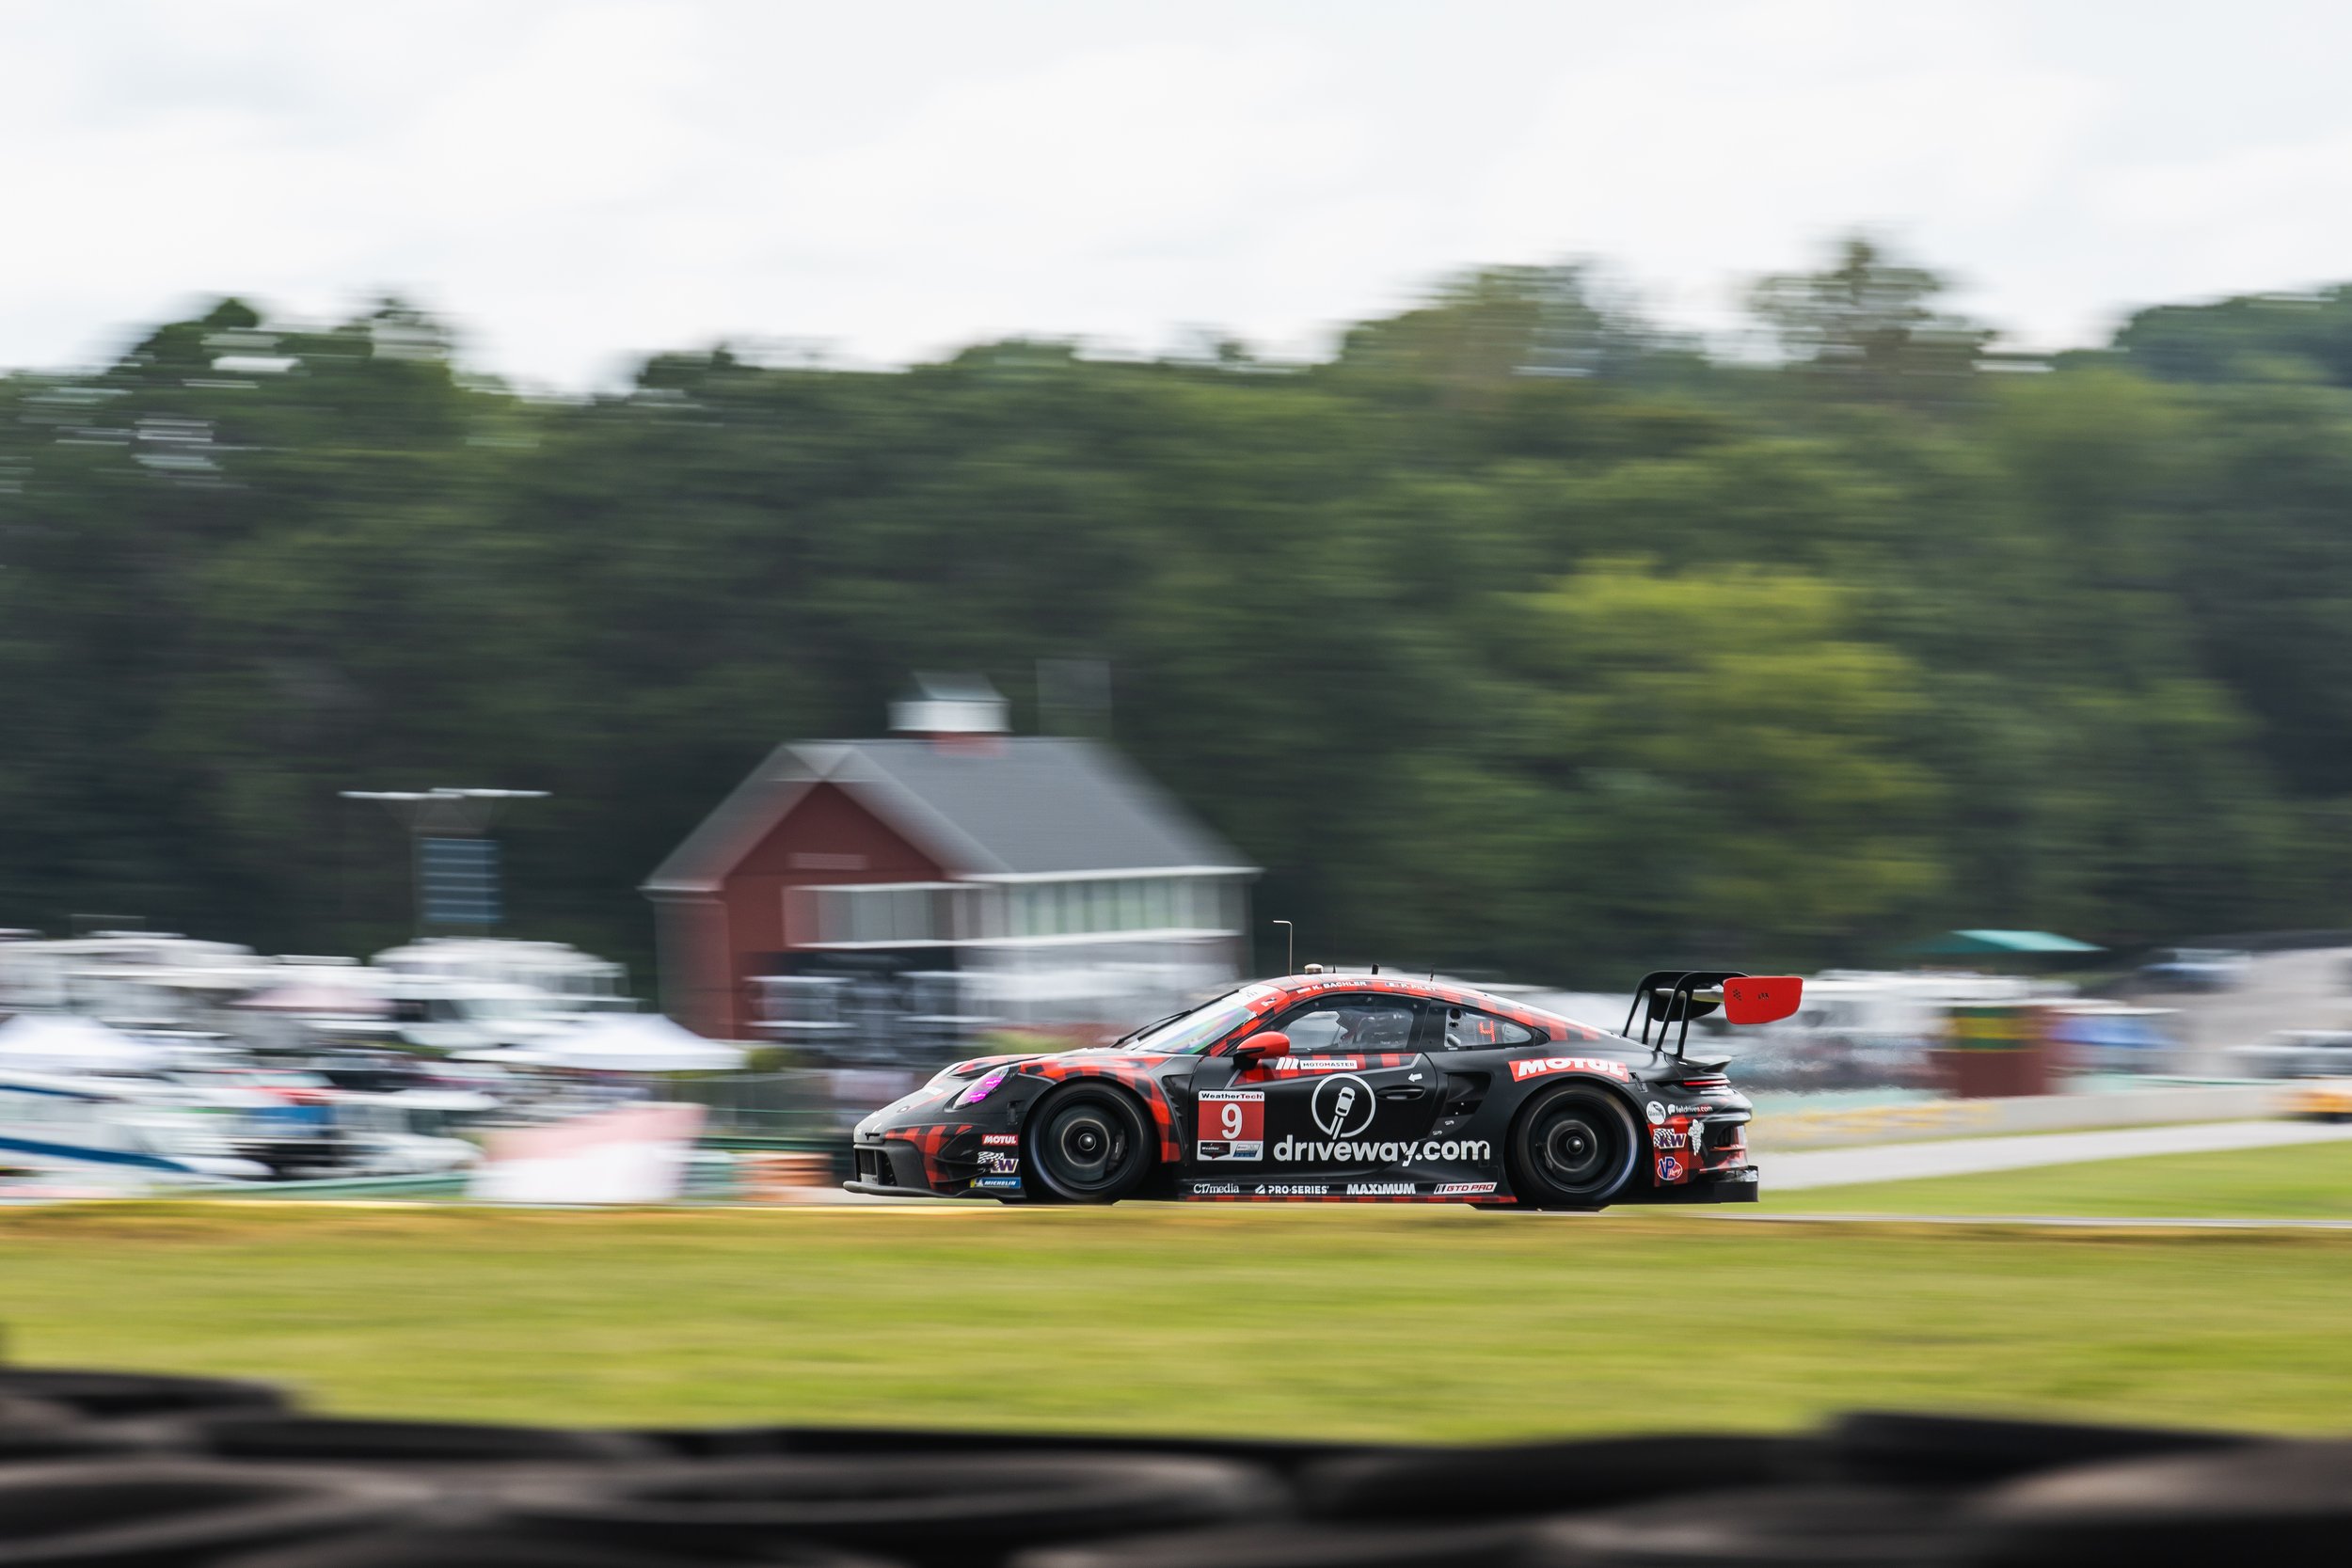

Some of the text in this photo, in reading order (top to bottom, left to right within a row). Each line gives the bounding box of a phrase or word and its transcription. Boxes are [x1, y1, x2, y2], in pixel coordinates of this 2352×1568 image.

[1478, 1021, 1496, 1043] 4
[1518, 1058, 1625, 1077] MOTUL
[1221, 1102, 1243, 1139] 9
[983, 1135, 1017, 1144] MOTUL
[1273, 1134, 1490, 1166] driveway.com
[1659, 1157, 1676, 1179] VP
[1193, 1183, 1240, 1194] C17media
[1346, 1183, 1416, 1195] MAXIMUM
